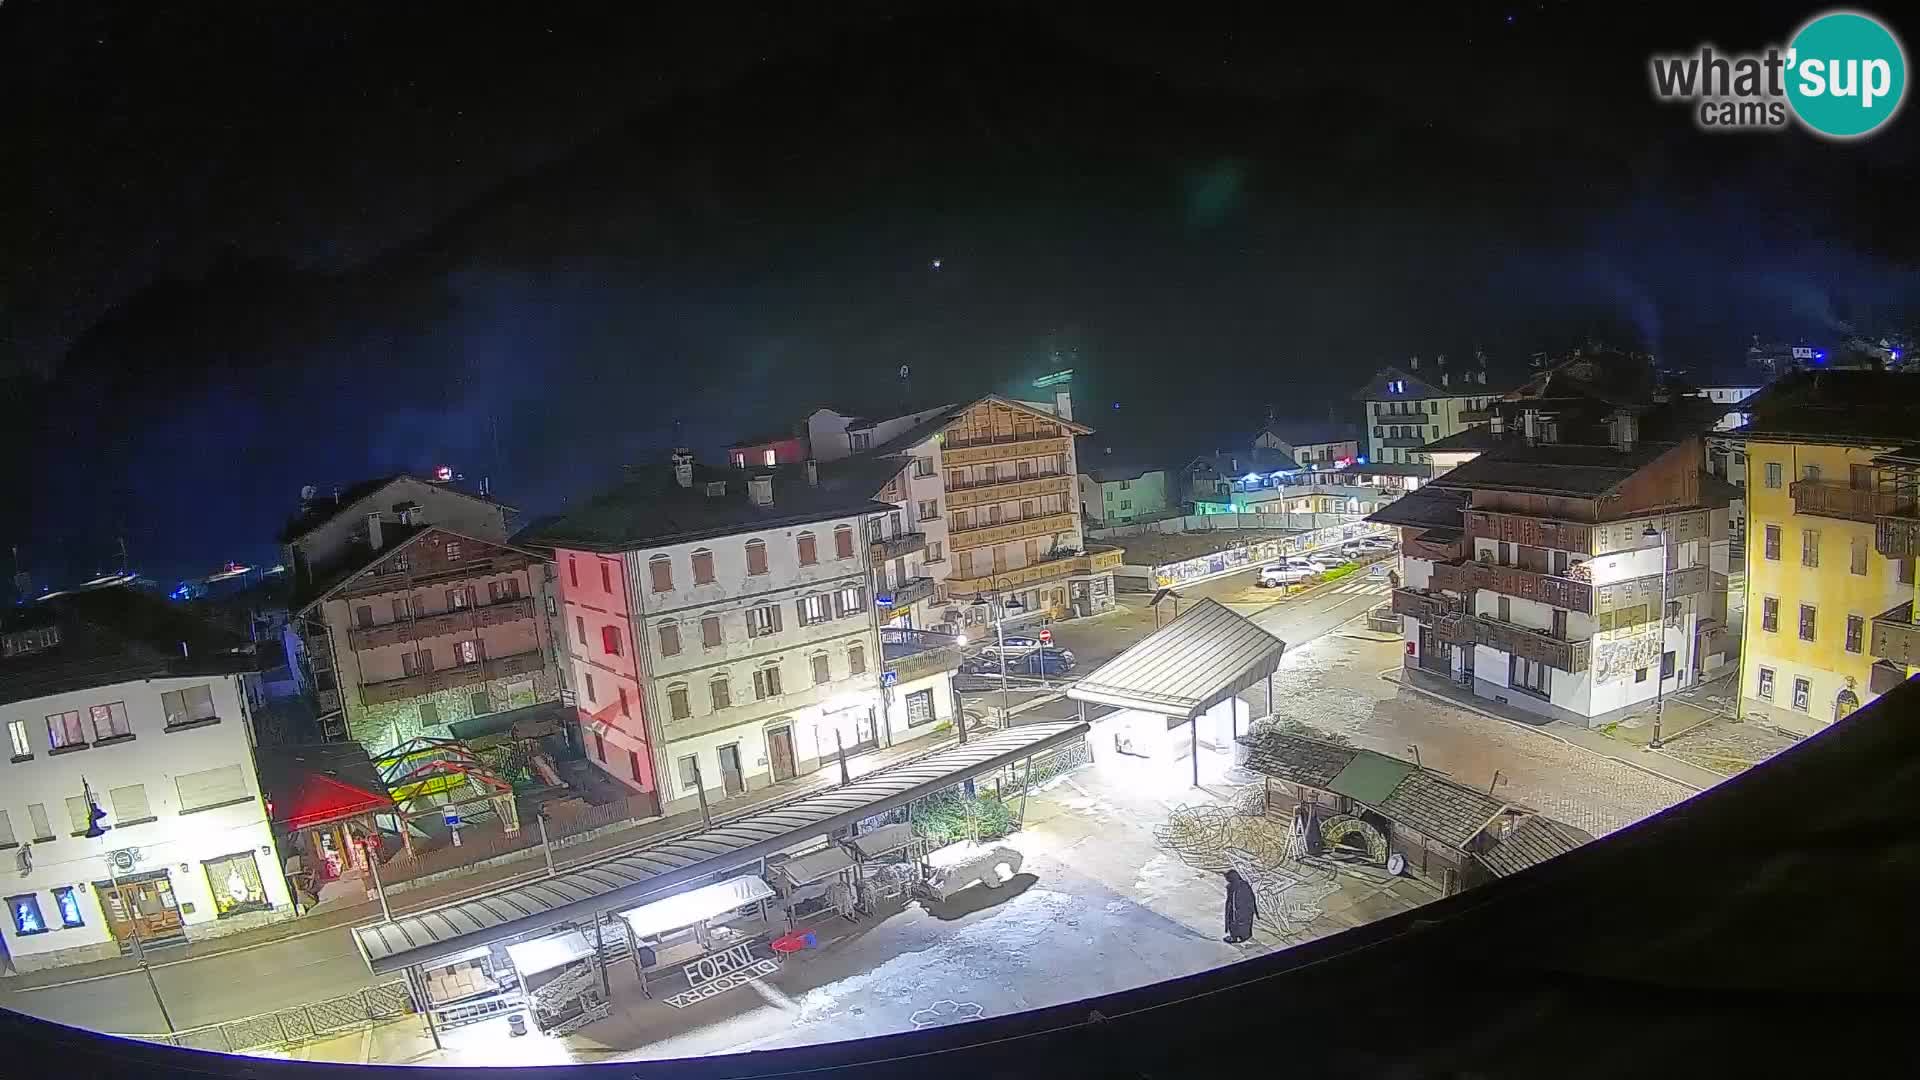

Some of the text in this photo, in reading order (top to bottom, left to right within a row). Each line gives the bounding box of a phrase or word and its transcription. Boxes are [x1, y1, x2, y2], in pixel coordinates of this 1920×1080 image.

[663, 959, 779, 1009] DI SOPRA
[683, 940, 755, 987] FORNI
